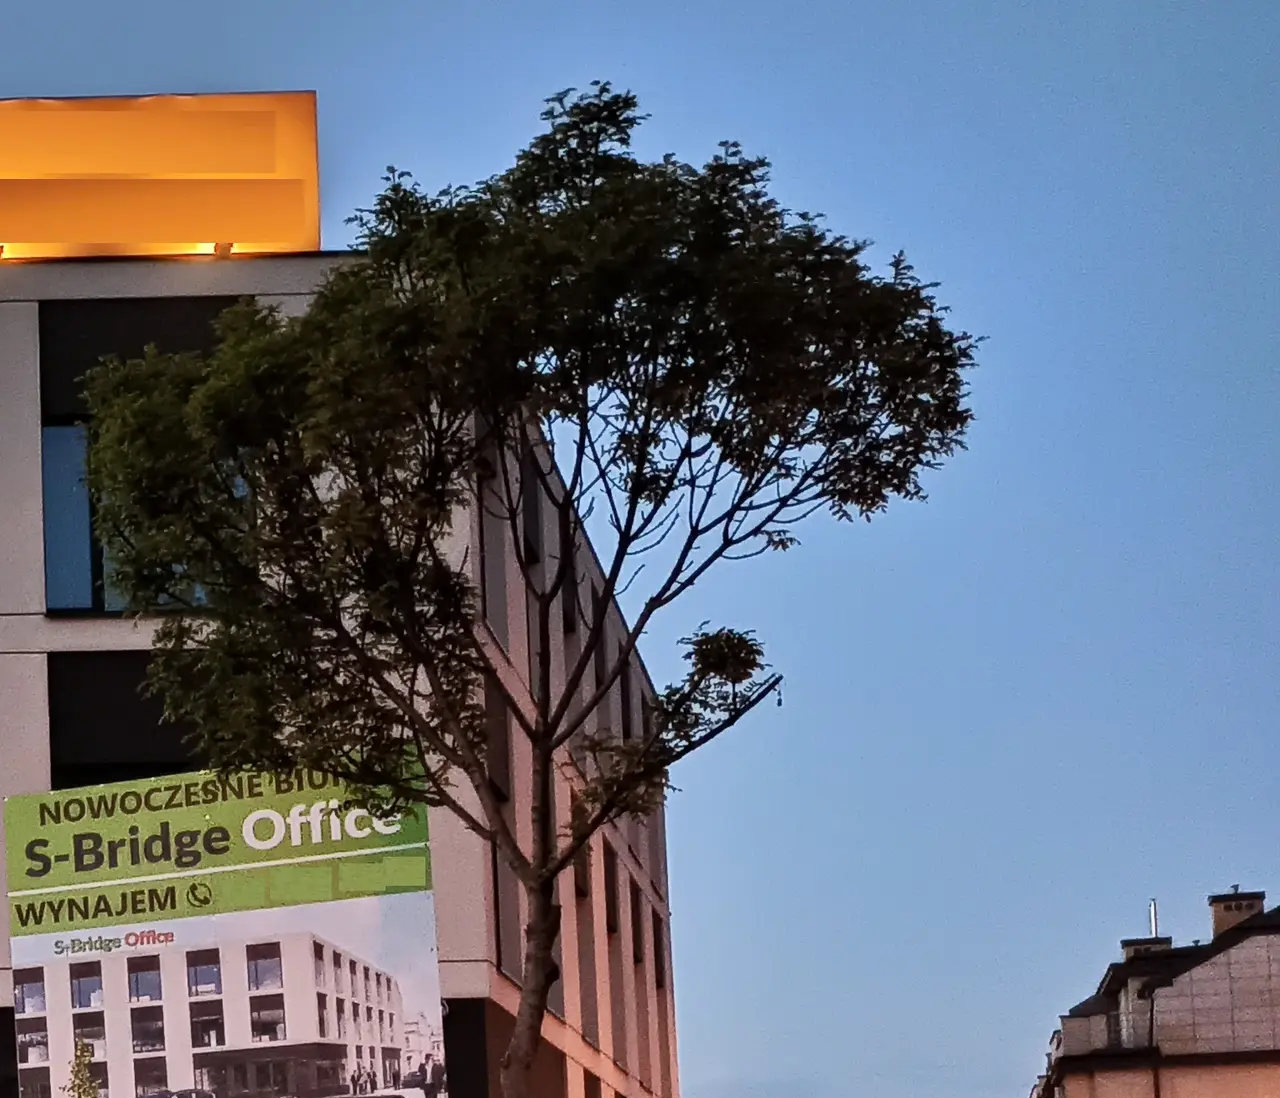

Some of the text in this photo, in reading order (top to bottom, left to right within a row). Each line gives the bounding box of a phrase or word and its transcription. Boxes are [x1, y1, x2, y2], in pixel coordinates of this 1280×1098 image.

[38, 772, 264, 827] NOWOCZESNE
[24, 798, 403, 879] S-Bridge Office
[14, 886, 178, 928] WYNAJEM
